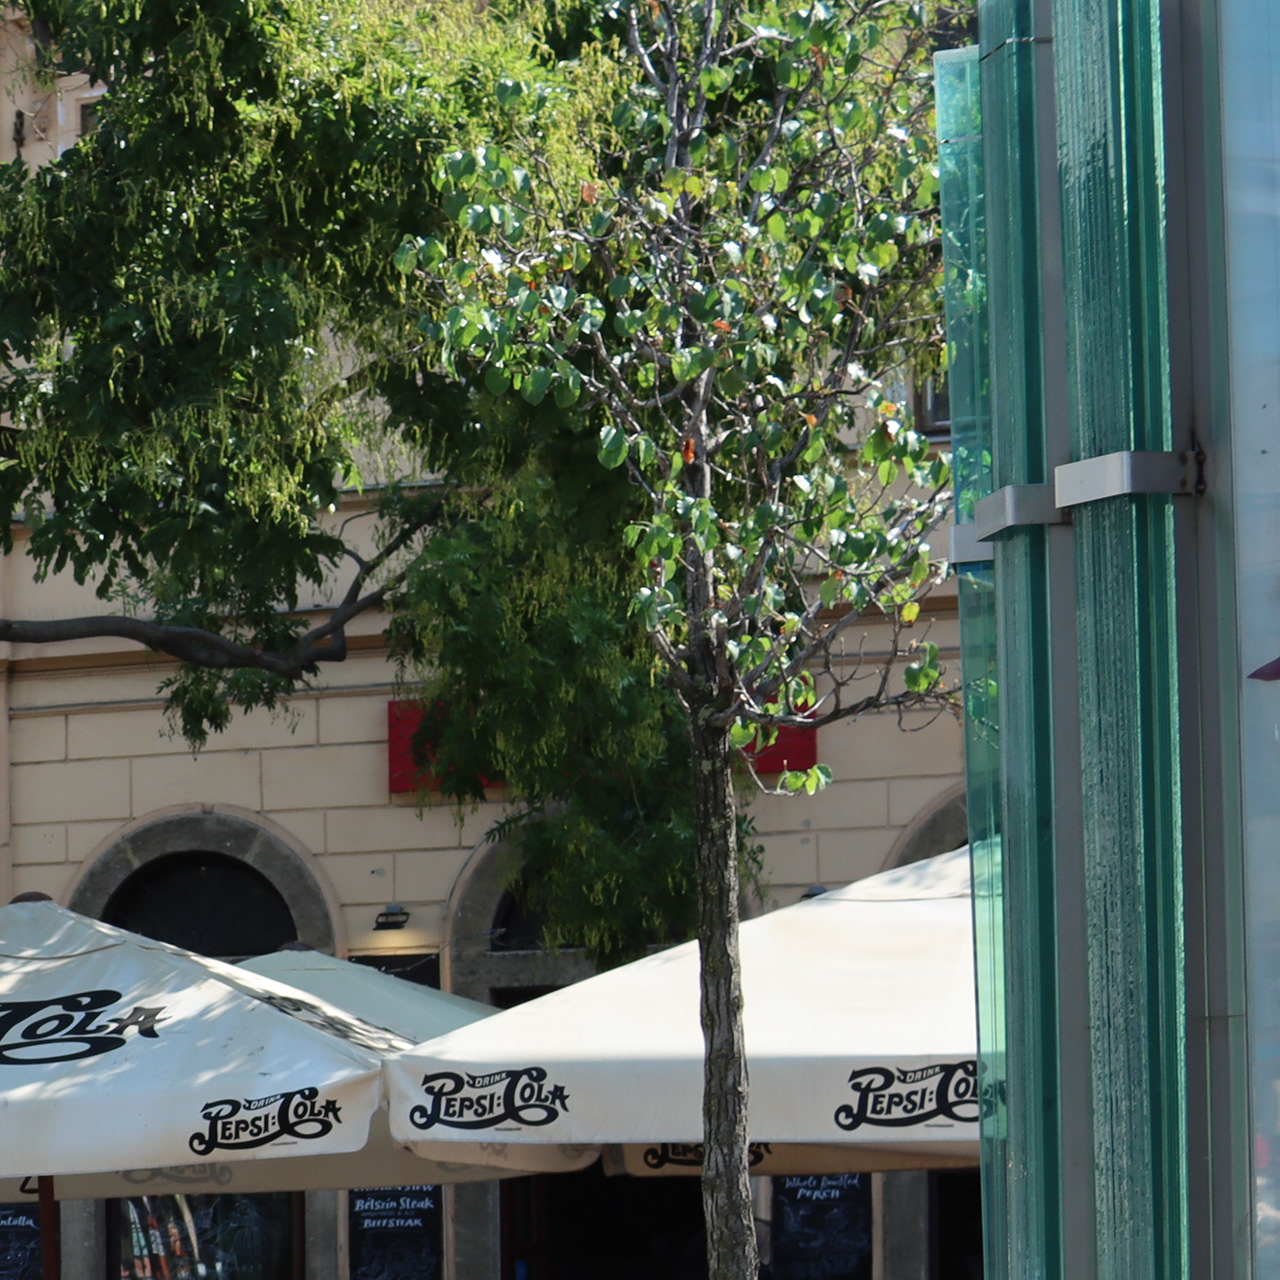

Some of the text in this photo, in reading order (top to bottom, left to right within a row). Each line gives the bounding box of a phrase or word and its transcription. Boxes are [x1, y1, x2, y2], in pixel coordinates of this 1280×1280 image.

[475, 1071, 507, 1087] DRINK
[906, 1066, 940, 1083] DRINK
[250, 1094, 282, 1110] DRINK
